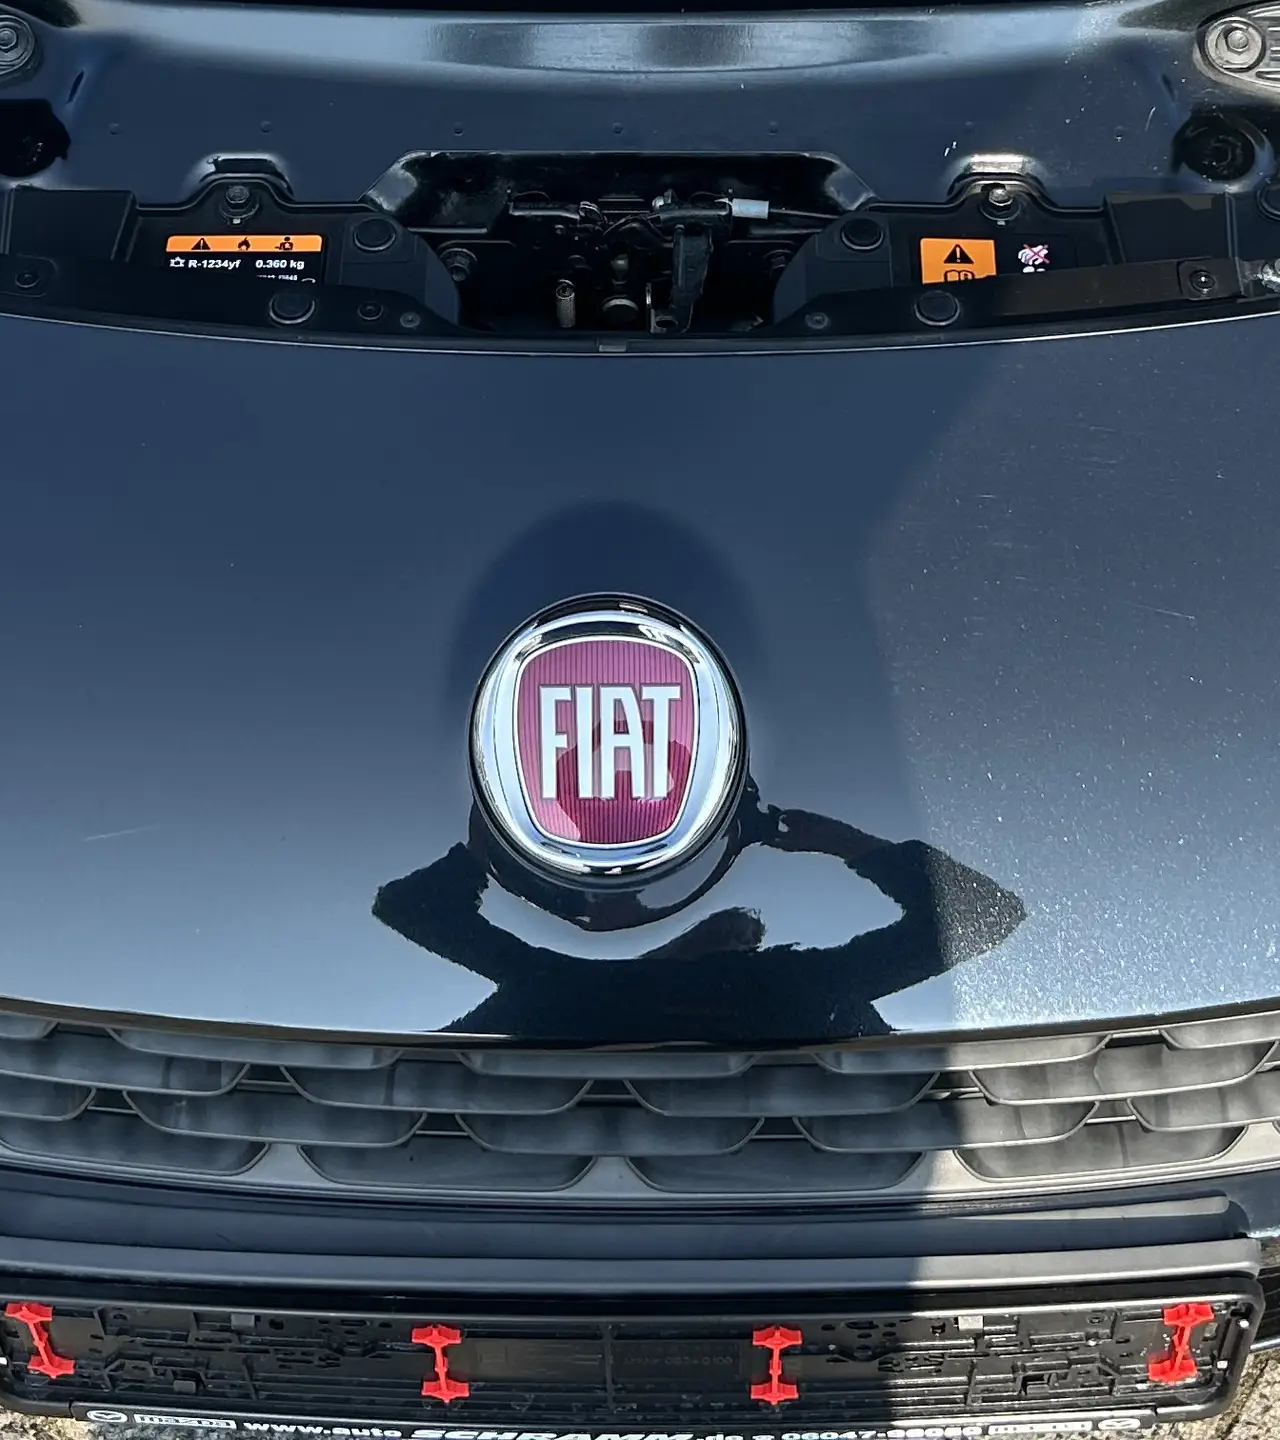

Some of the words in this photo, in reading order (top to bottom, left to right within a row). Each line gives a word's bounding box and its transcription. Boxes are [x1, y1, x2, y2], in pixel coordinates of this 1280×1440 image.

[188, 259, 241, 270] R-1234yf
[255, 259, 287, 269] 0.360
[289, 259, 305, 270] kg
[539, 683, 681, 801] FIAT
